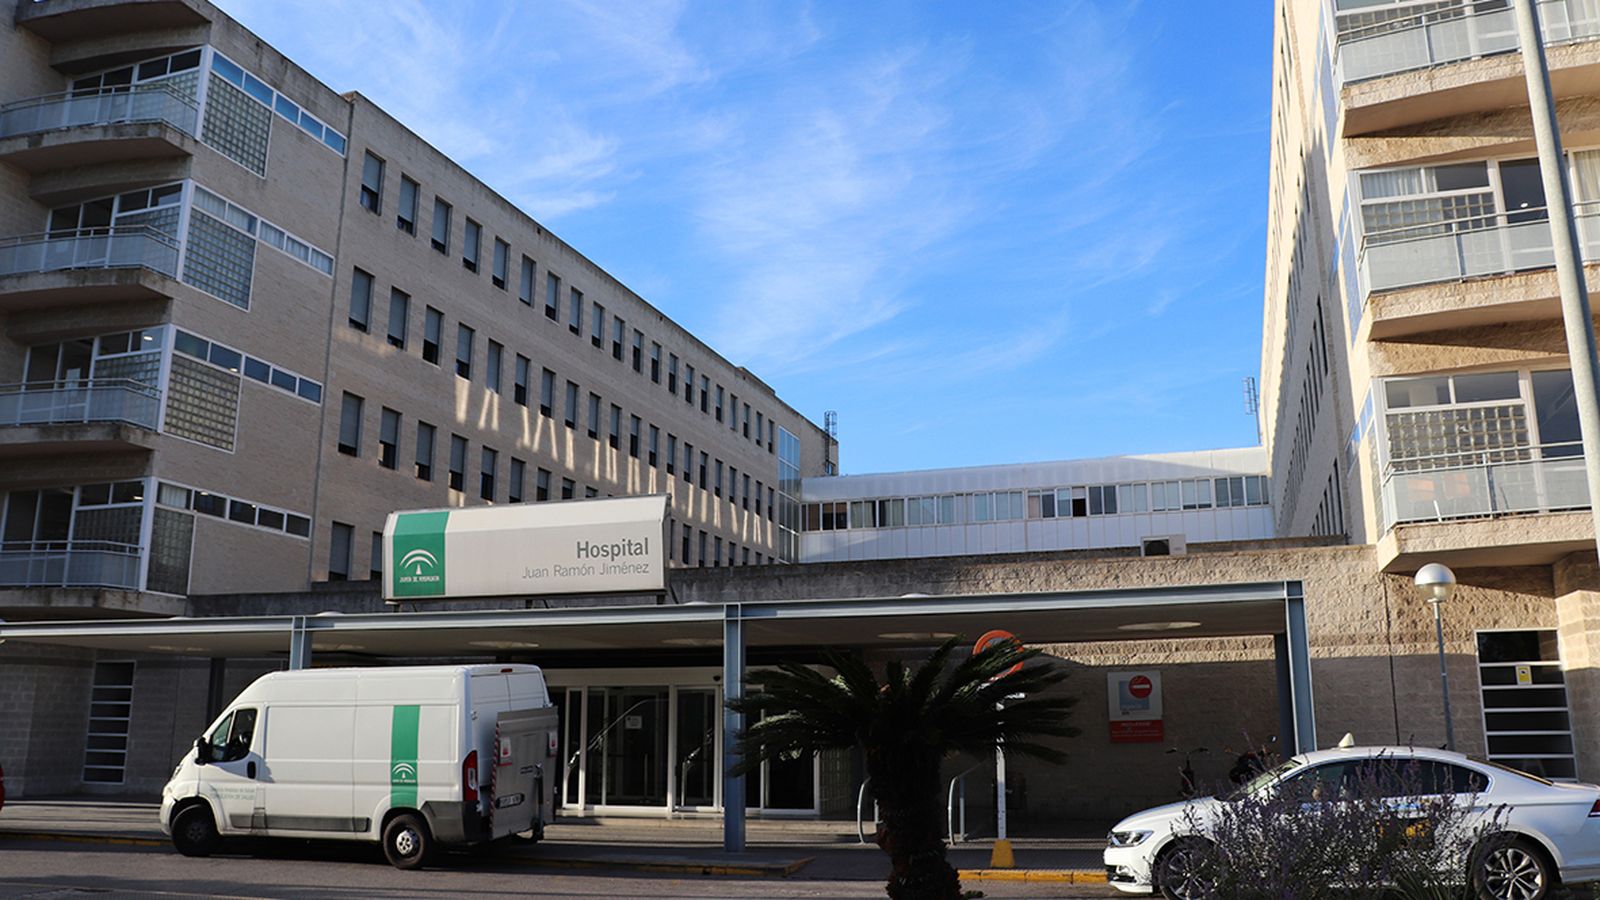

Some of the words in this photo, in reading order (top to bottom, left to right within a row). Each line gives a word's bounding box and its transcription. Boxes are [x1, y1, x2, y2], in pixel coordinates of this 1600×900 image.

[577, 537, 649, 562] Hospital
[522, 566, 549, 579] Juan
[553, 563, 595, 577] Ramón
[599, 561, 649, 576] Jiménez
